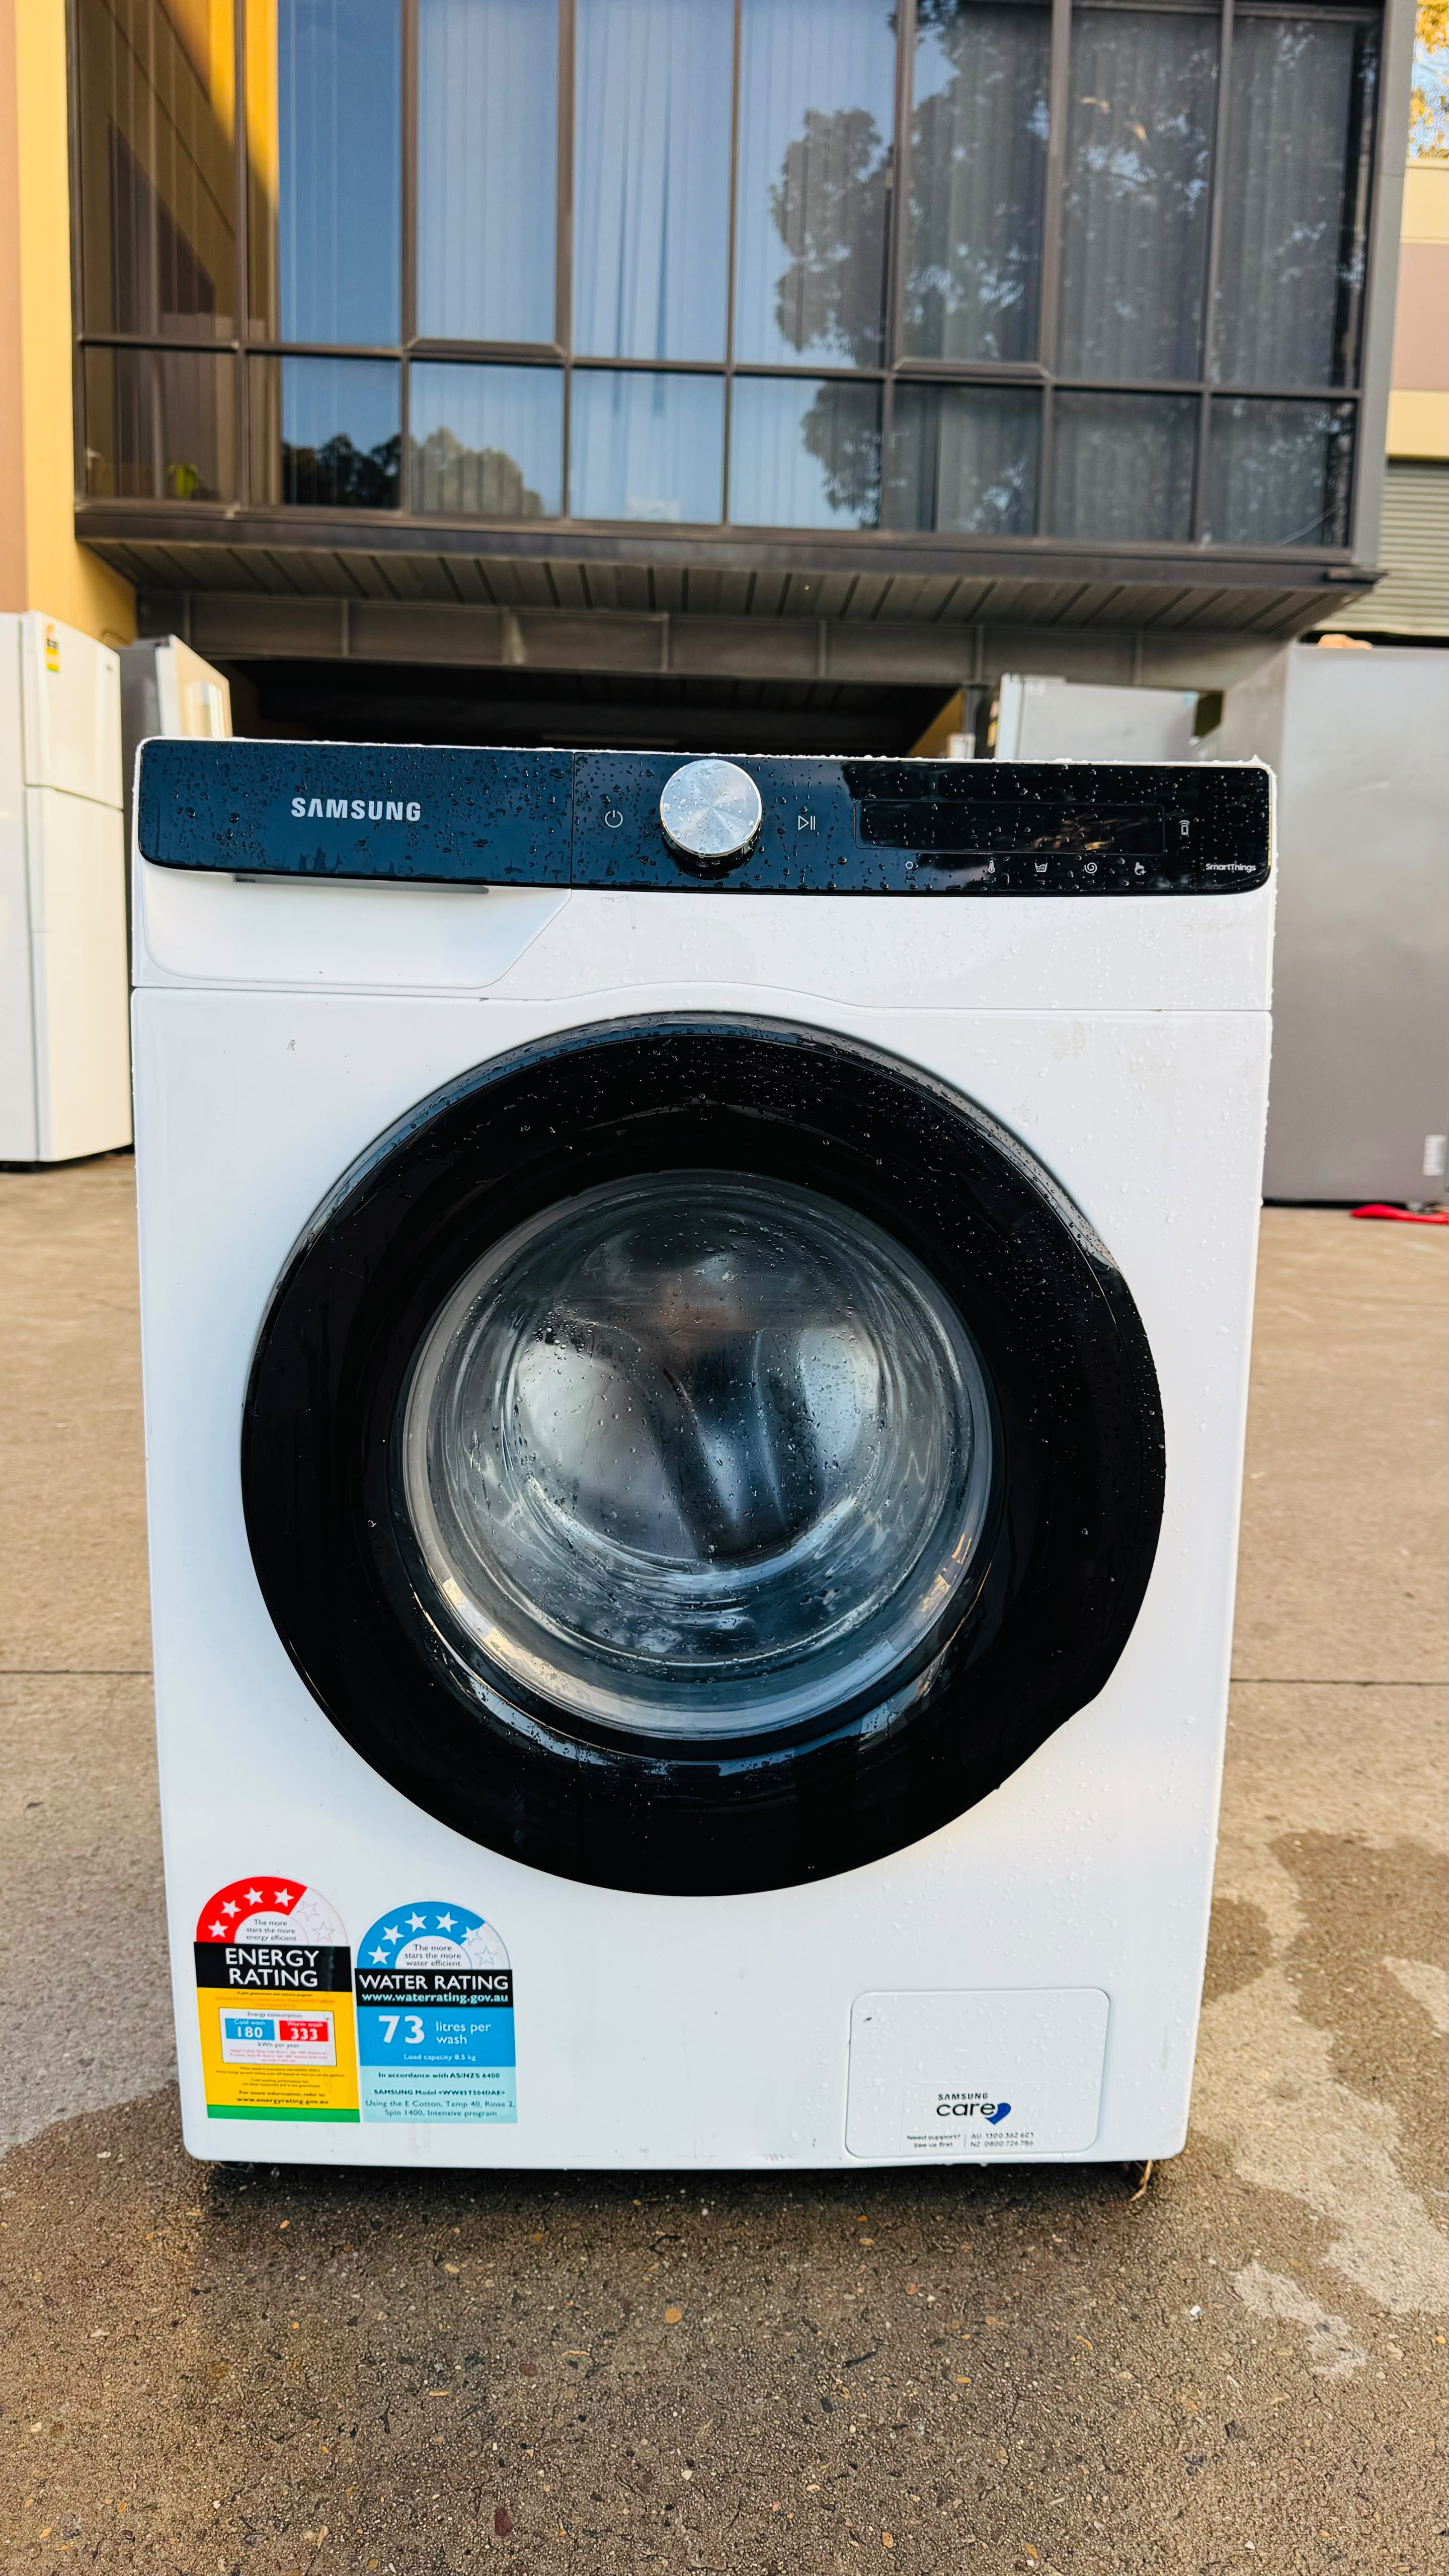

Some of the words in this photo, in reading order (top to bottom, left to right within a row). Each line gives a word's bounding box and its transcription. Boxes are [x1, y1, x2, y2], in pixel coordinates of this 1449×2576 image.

[291, 797, 421, 822] SAMSUNG
[1205, 863, 1256, 873] SmartThings
[225, 1948, 319, 1967] ENERGY
[229, 1968, 318, 1987] RATING
[359, 1974, 428, 1990] WATER
[434, 1975, 508, 1990] RATING
[362, 1992, 508, 2004] www.waterrating.gov.au
[237, 2026, 263, 2038] 180
[290, 2027, 318, 2041] 333
[378, 2015, 425, 2044] 73
[436, 2021, 466, 2032] litres
[470, 2023, 491, 2034] per
[436, 2034, 467, 2044] wash
[938, 2092, 988, 2101] SAMSUNG
[366, 2100, 387, 2108] Using
[936, 2103, 996, 2116] care
[385, 2109, 401, 2117] Spin
